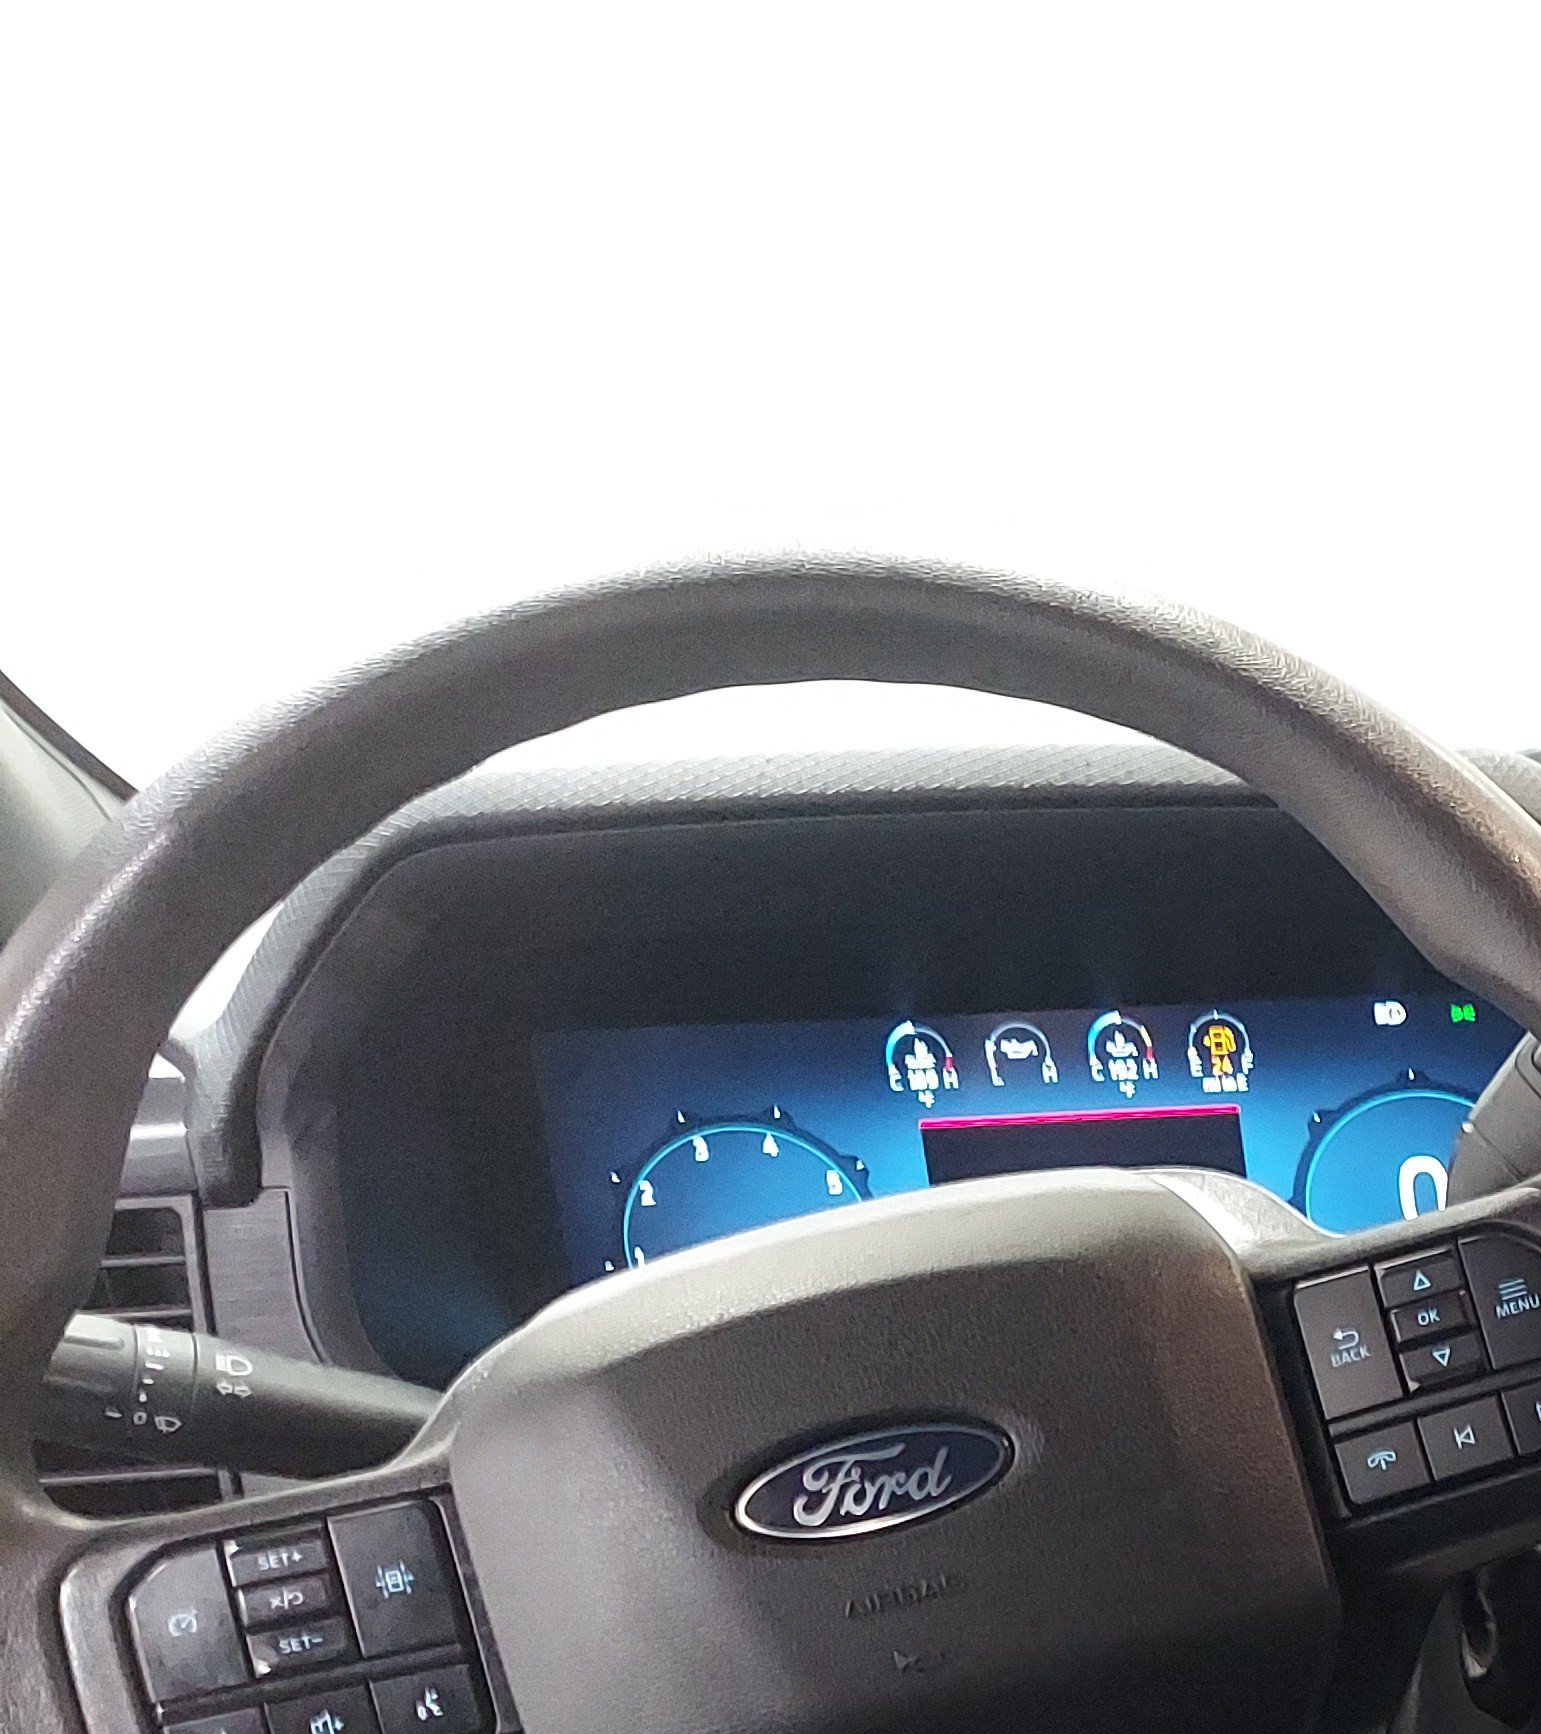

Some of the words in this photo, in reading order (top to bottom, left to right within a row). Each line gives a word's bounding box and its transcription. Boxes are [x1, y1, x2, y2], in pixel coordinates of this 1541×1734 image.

[1417, 1308, 1441, 1326] OK
[1495, 1293, 1541, 1320] MENU
[1330, 1345, 1371, 1368] BACK
[793, 1443, 951, 1527] Ford
